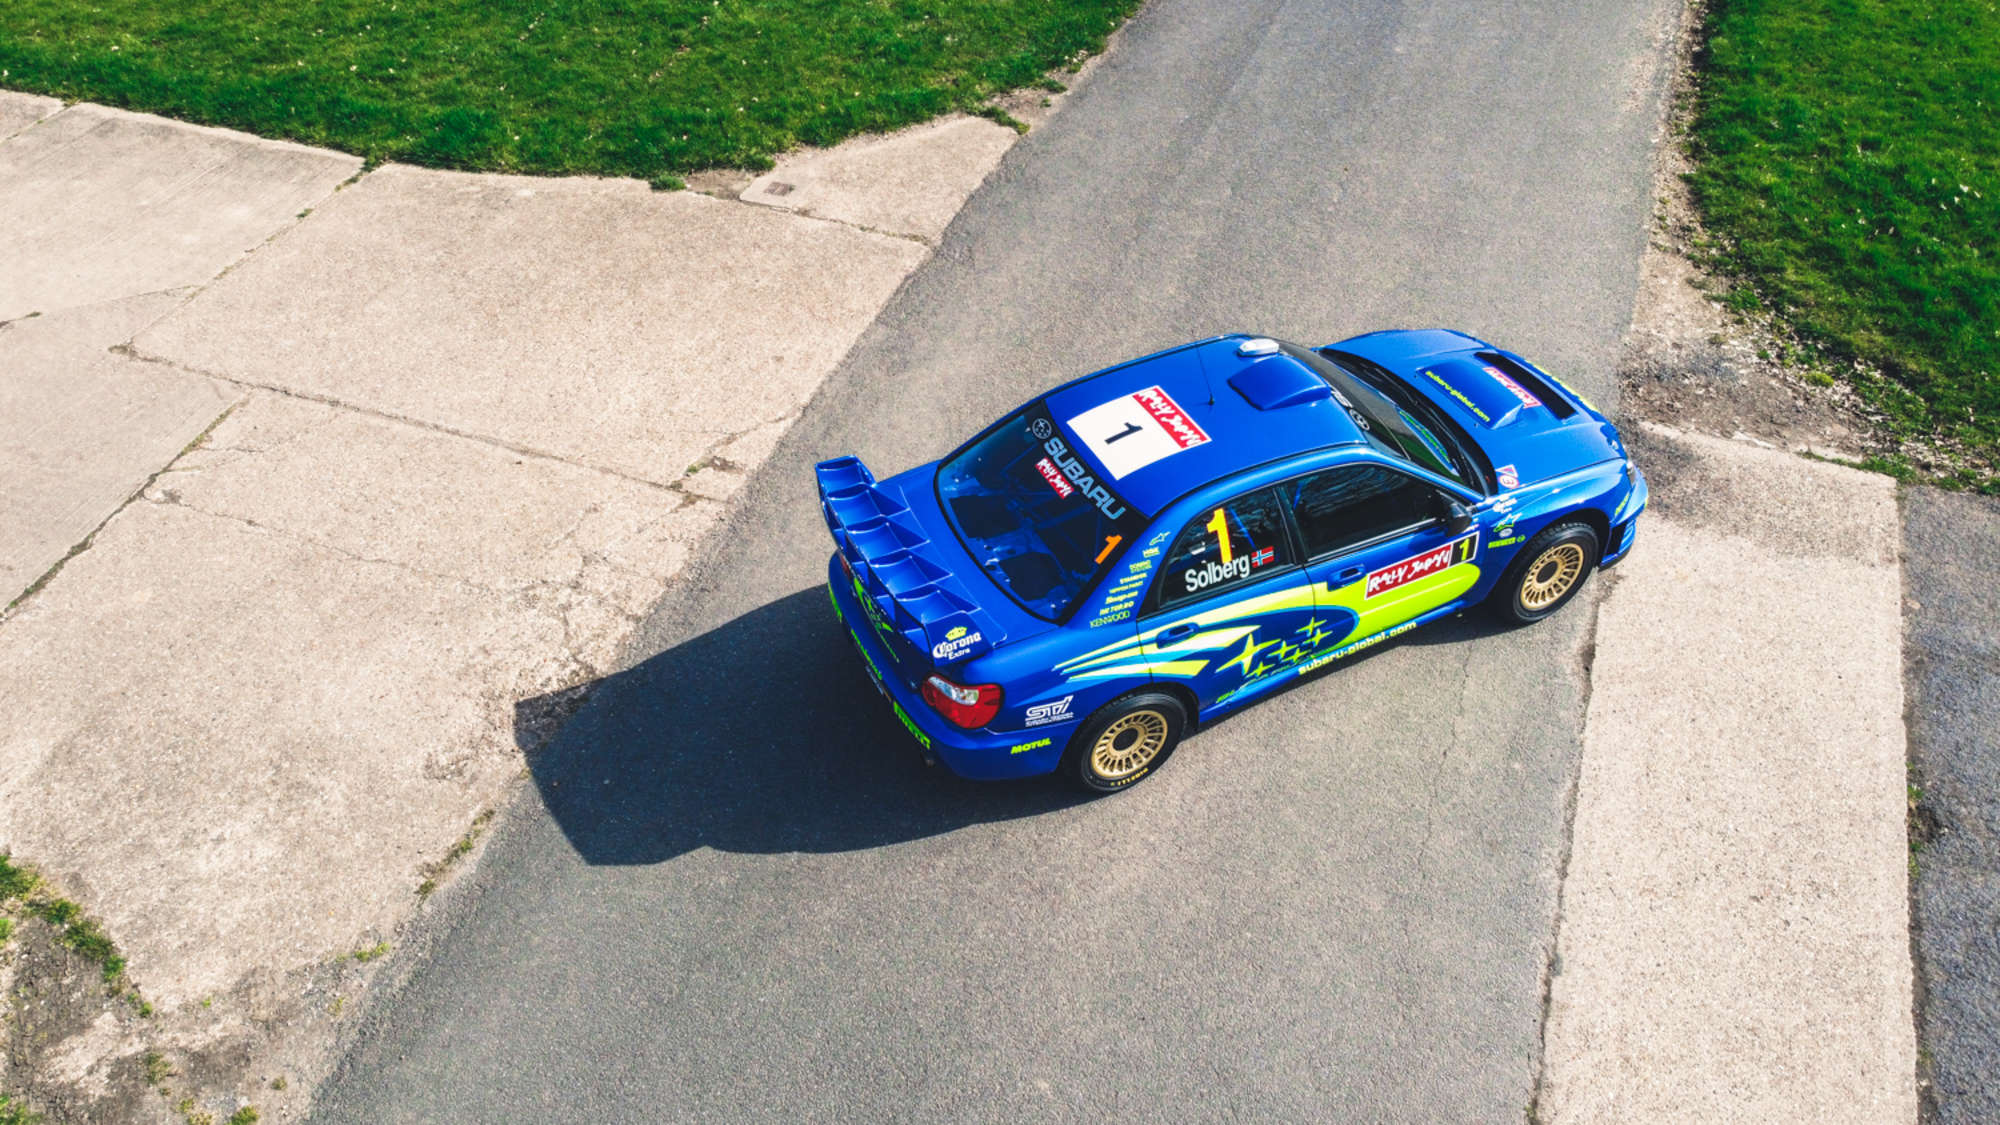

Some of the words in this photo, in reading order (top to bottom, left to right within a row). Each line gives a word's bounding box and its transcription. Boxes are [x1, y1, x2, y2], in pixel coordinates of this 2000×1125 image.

[1104, 421, 1143, 445] 1
[1044, 436, 1126, 520] SUBARU
[1094, 534, 1123, 565] 1
[1206, 507, 1233, 564] 1
[1459, 537, 1470, 561] 1
[1185, 554, 1250, 592] Solberg
[1089, 610, 1131, 628] KENWOOD
[932, 632, 982, 659] Corona
[1298, 621, 1417, 676] subaru-global.com
[1010, 737, 1052, 755] MOTUL
